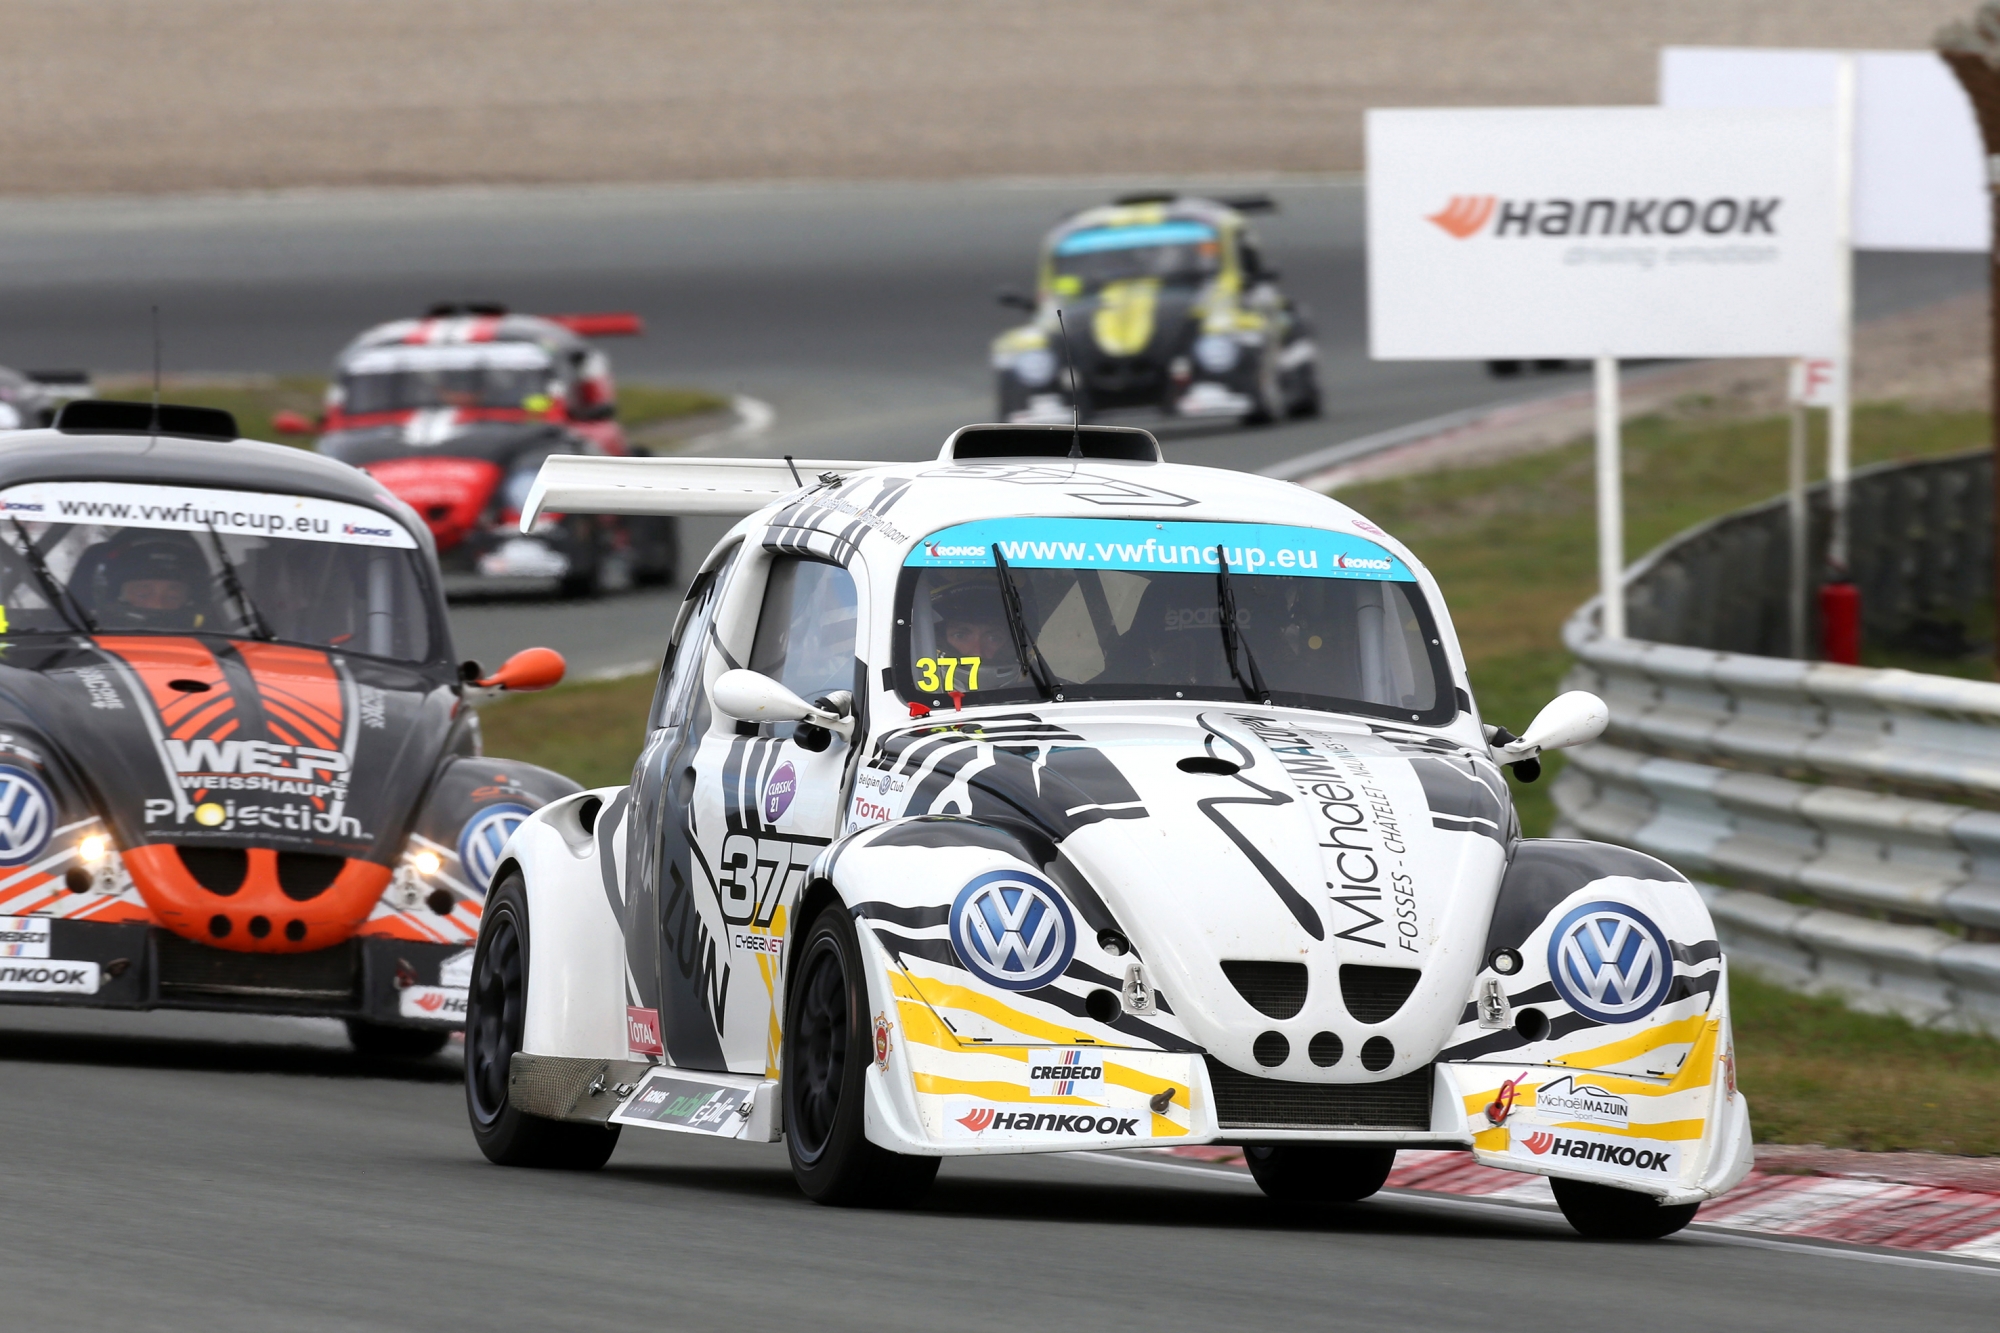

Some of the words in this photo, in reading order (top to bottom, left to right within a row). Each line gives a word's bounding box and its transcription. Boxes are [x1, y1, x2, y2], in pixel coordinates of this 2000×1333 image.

[58, 500, 329, 534] www.vwfuncup.eu
[925, 541, 986, 557] KRONOS
[999, 538, 1320, 573] www.vwfuncup.eu
[1332, 551, 1391, 570] KRONOS
[1164, 606, 1251, 632] sparo
[915, 656, 982, 693] 377
[179, 775, 349, 801] WEISSHAUPT
[768, 779, 794, 796] CLASSIC
[859, 773, 880, 789] Belgian
[889, 780, 905, 793] Club
[769, 796, 779, 813] 21
[1391, 872, 1420, 954] FOSSES
[1030, 1066, 1102, 1081] CREDECO
